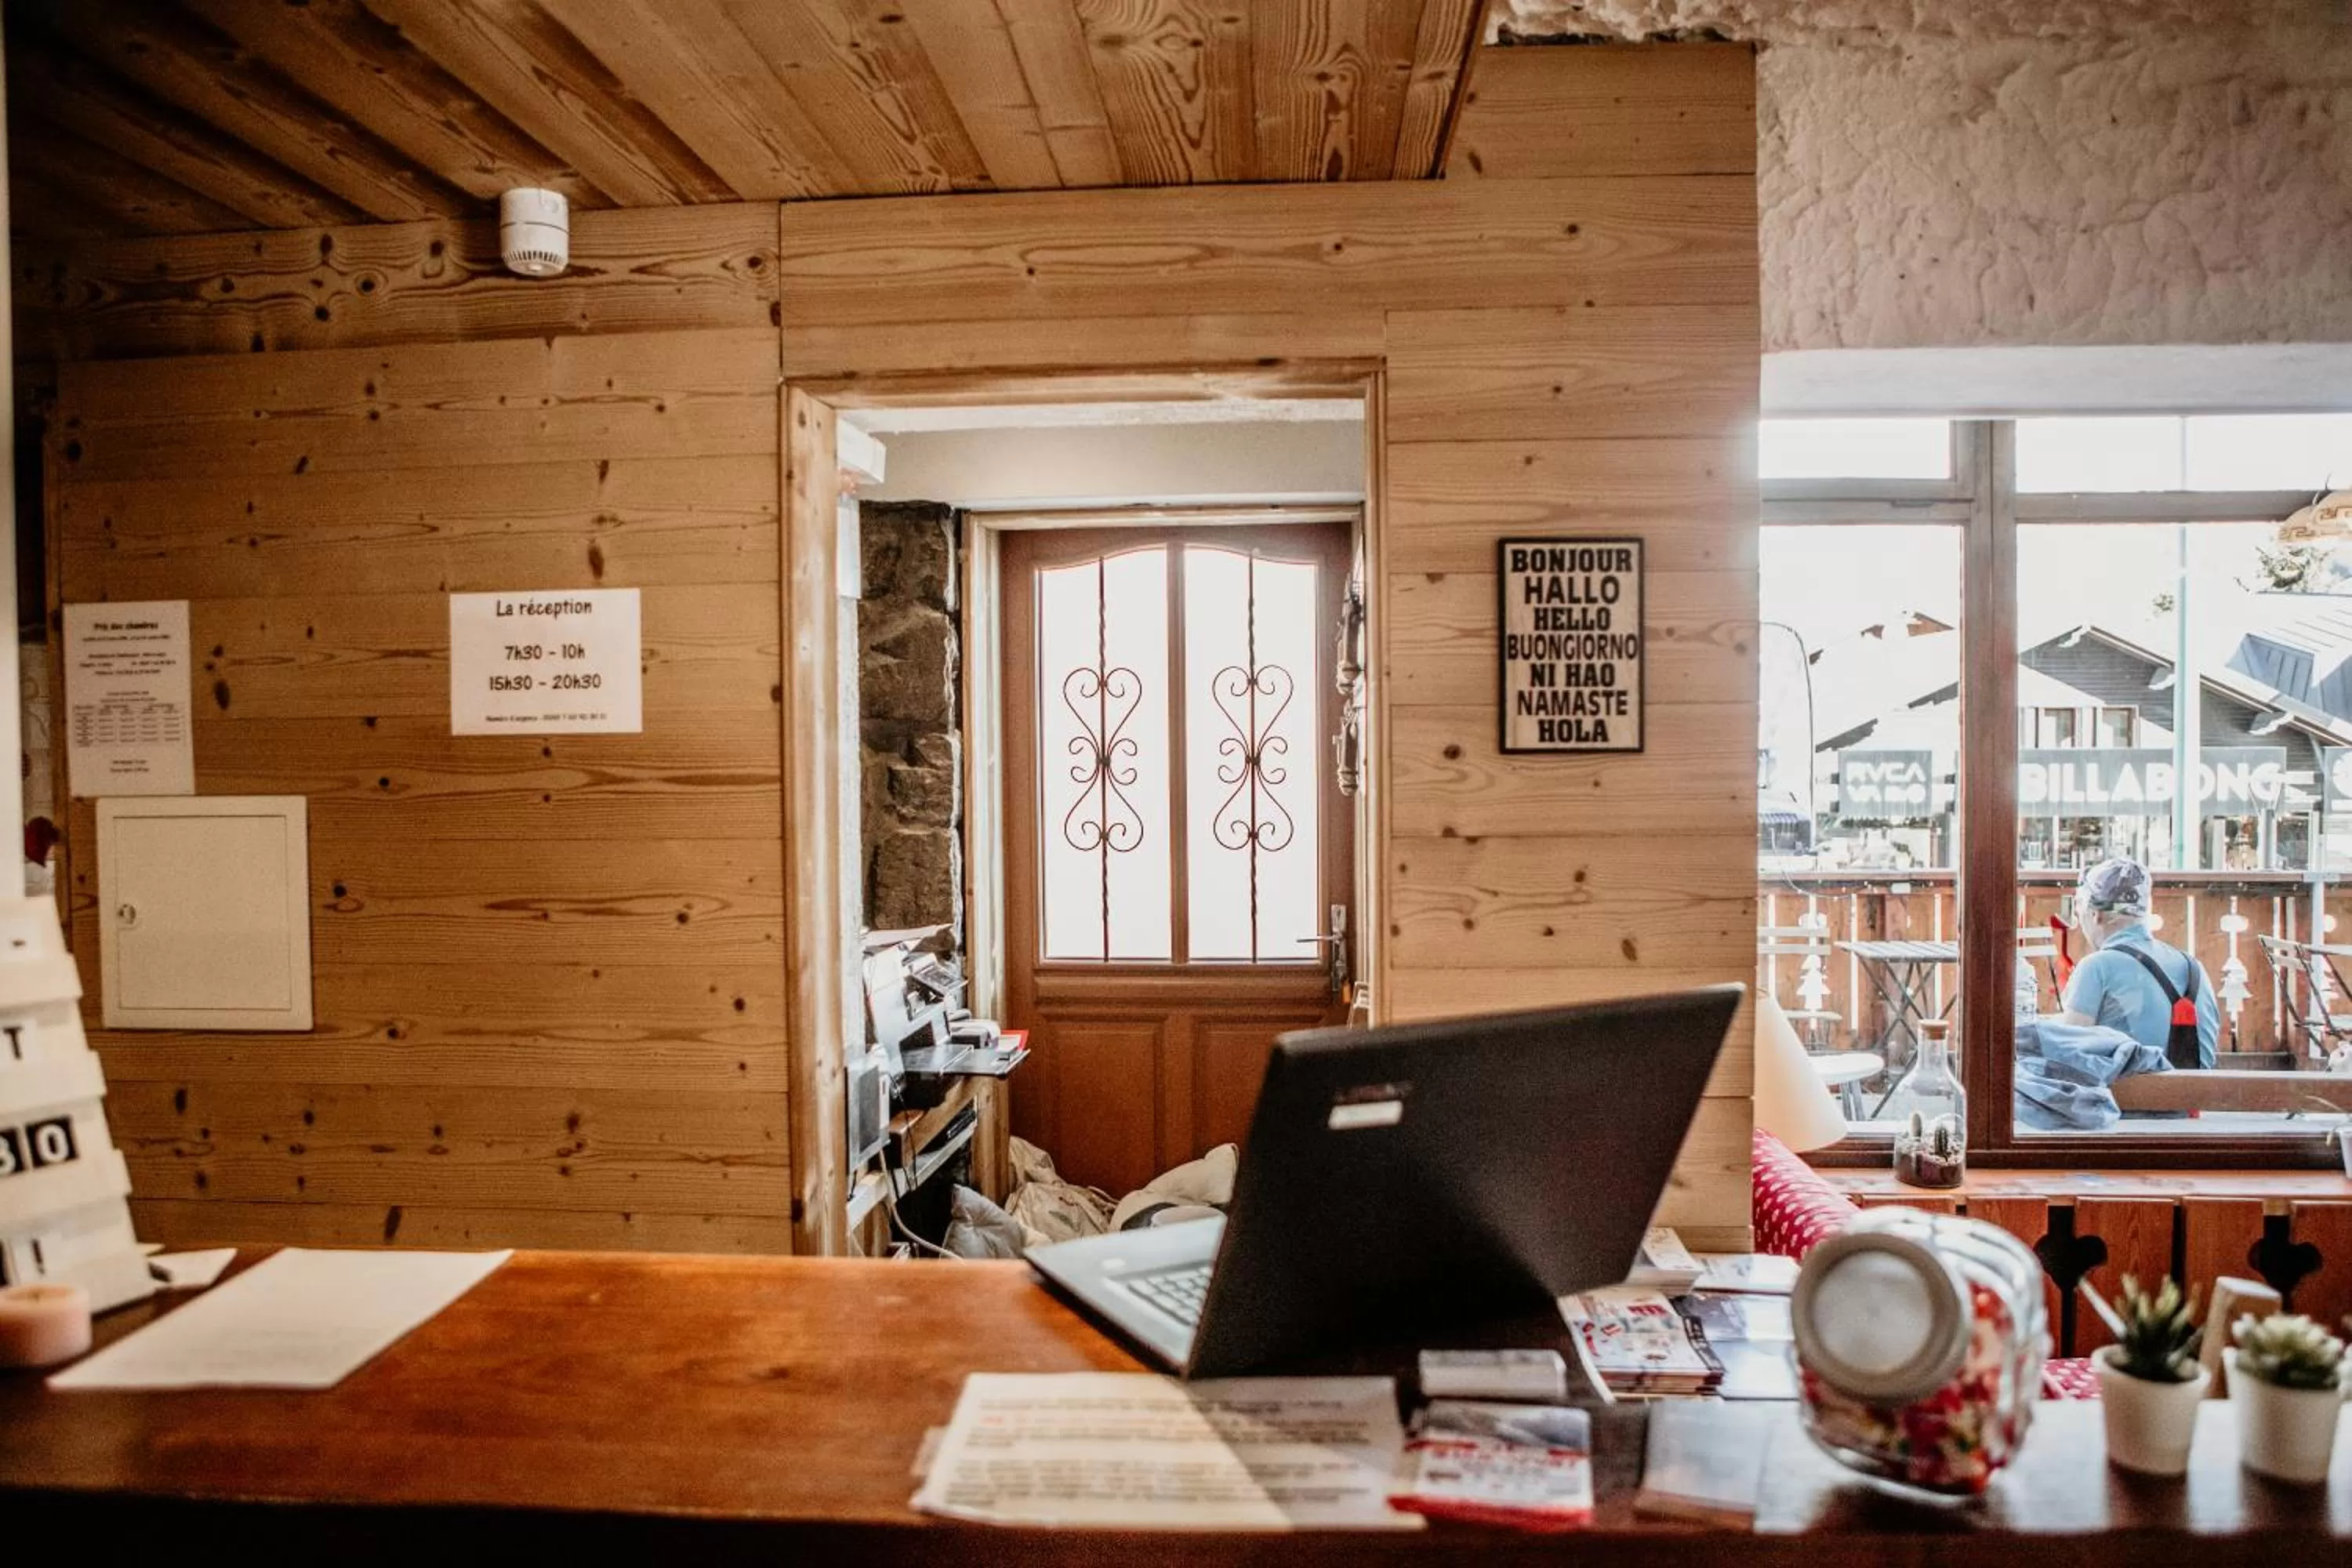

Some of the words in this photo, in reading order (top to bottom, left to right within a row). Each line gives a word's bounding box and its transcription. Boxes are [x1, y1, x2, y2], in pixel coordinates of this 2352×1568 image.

[1511, 548, 1632, 572] BONJOUR
[1524, 575, 1620, 604] HALLO
[495, 599, 514, 617] La
[519, 597, 592, 620] réception
[1534, 607, 1611, 631] HELLO
[505, 644, 543, 660] 7h30
[561, 643, 586, 659] 10h
[1507, 633, 1639, 660] BUONGIORNO
[489, 675, 533, 691] 15h30
[552, 673, 601, 690] 20h30
[1530, 663, 1556, 688] NI
[1565, 663, 1616, 688] HAO
[1516, 690, 1628, 716] NAMASTE
[1537, 719, 1609, 742] HOLA
